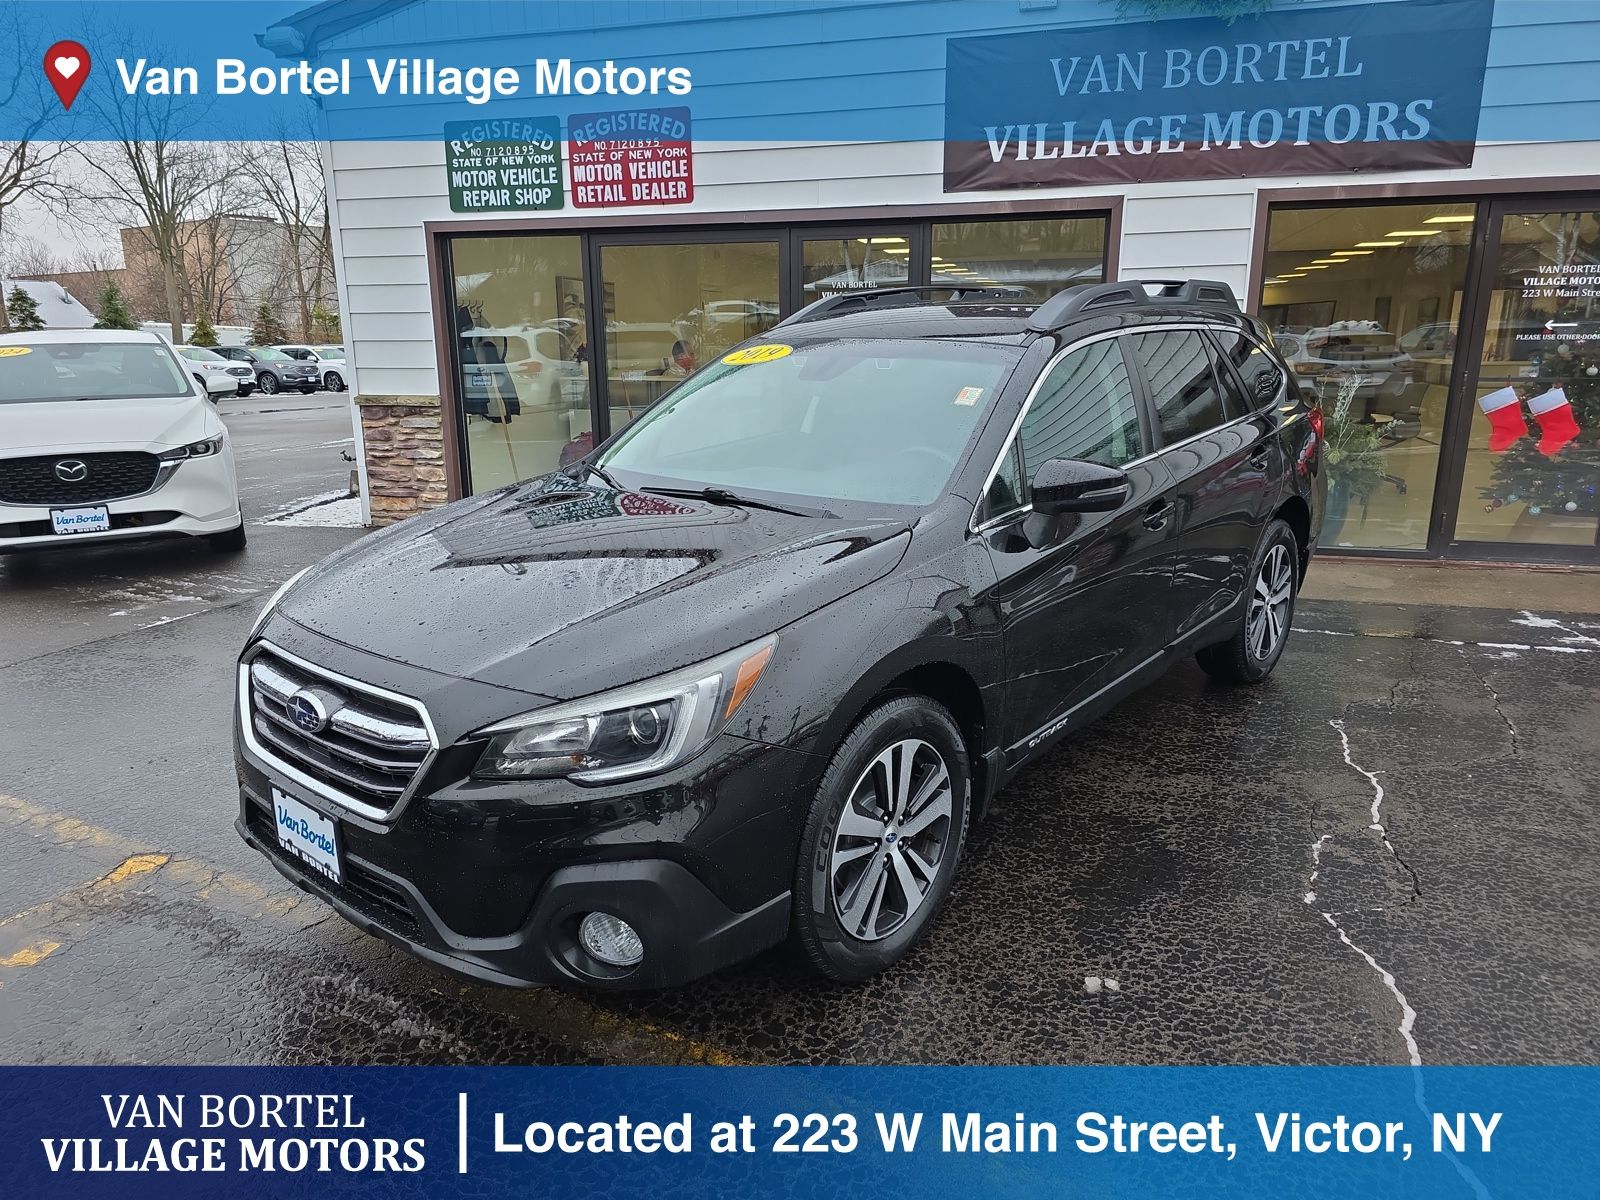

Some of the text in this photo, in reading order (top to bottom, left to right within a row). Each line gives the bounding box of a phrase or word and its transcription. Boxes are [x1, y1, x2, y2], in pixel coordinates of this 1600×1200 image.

[1050, 36, 1363, 97] VAN BORTEL
[450, 121, 554, 156] REGISTERED
[573, 112, 687, 148] REGISTERED
[983, 99, 1434, 163] VILLAGE MOTORS
[485, 145, 535, 157] 7120895
[572, 147, 688, 163] STATE OF NEW YORK
[452, 154, 555, 168] STATE OF NEW YORK
[452, 167, 558, 188] MOTOR VEHICLE
[573, 159, 688, 183] MOTOR VEHICLE
[462, 187, 552, 207] REPAIR SHOP
[577, 181, 687, 203] RETAIL DEALER
[1539, 265, 1561, 274] VAN
[831, 280, 878, 289] VAN BORTEL
[1523, 277, 1567, 286] VILLAGE
[1522, 289, 1541, 298] 223
[1543, 289, 1554, 297] W
[1555, 288, 1579, 297] Main
[1515, 333, 1541, 341] PLEASE
[1542, 333, 1556, 341] USE
[56, 514, 105, 525] Van Bortel
[278, 804, 335, 857] Van Bortel
